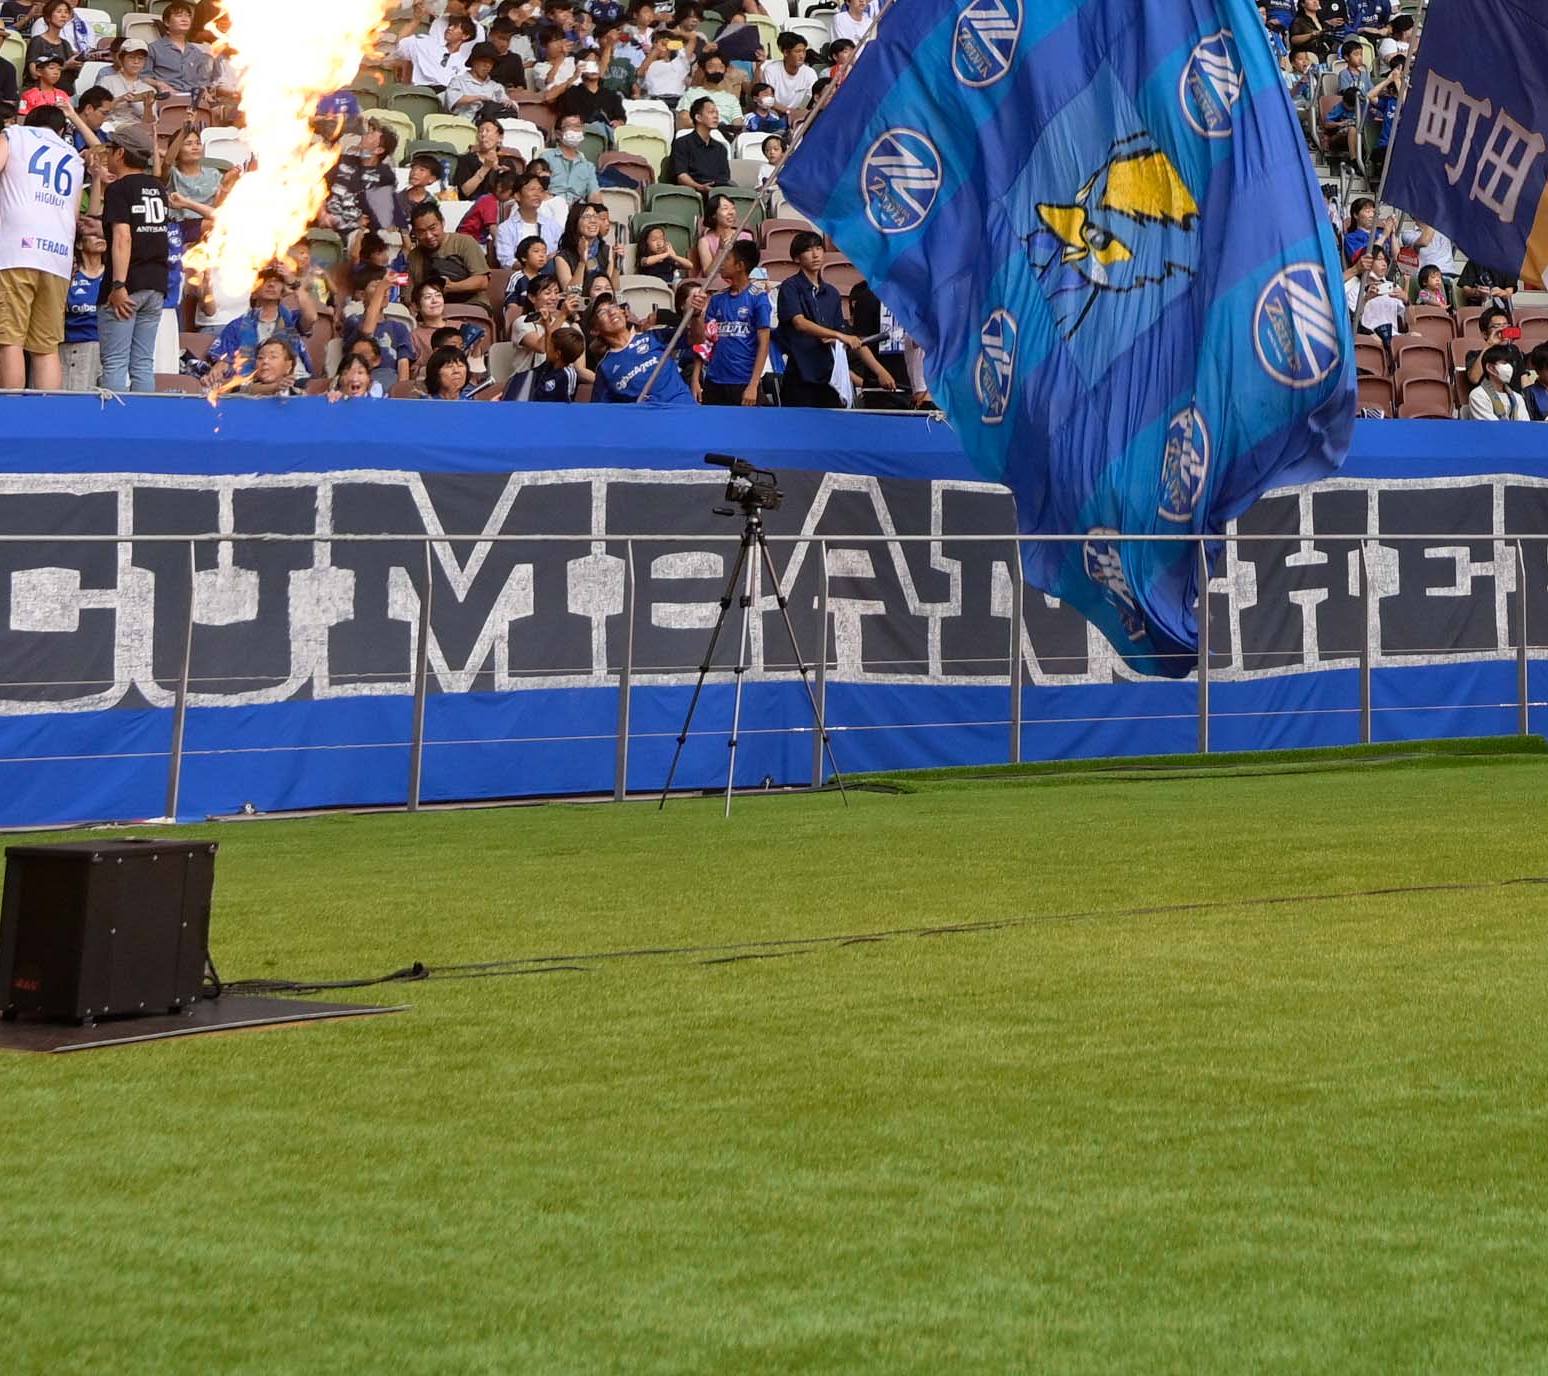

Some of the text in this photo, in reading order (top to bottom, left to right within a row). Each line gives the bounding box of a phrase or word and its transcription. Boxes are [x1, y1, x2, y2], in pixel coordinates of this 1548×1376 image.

[1413, 69, 1548, 225] 町田
[27, 143, 74, 198] 46
[142, 196, 166, 224] 10
[35, 237, 70, 257] TERADA
[614, 356, 659, 392] CyberAgent
